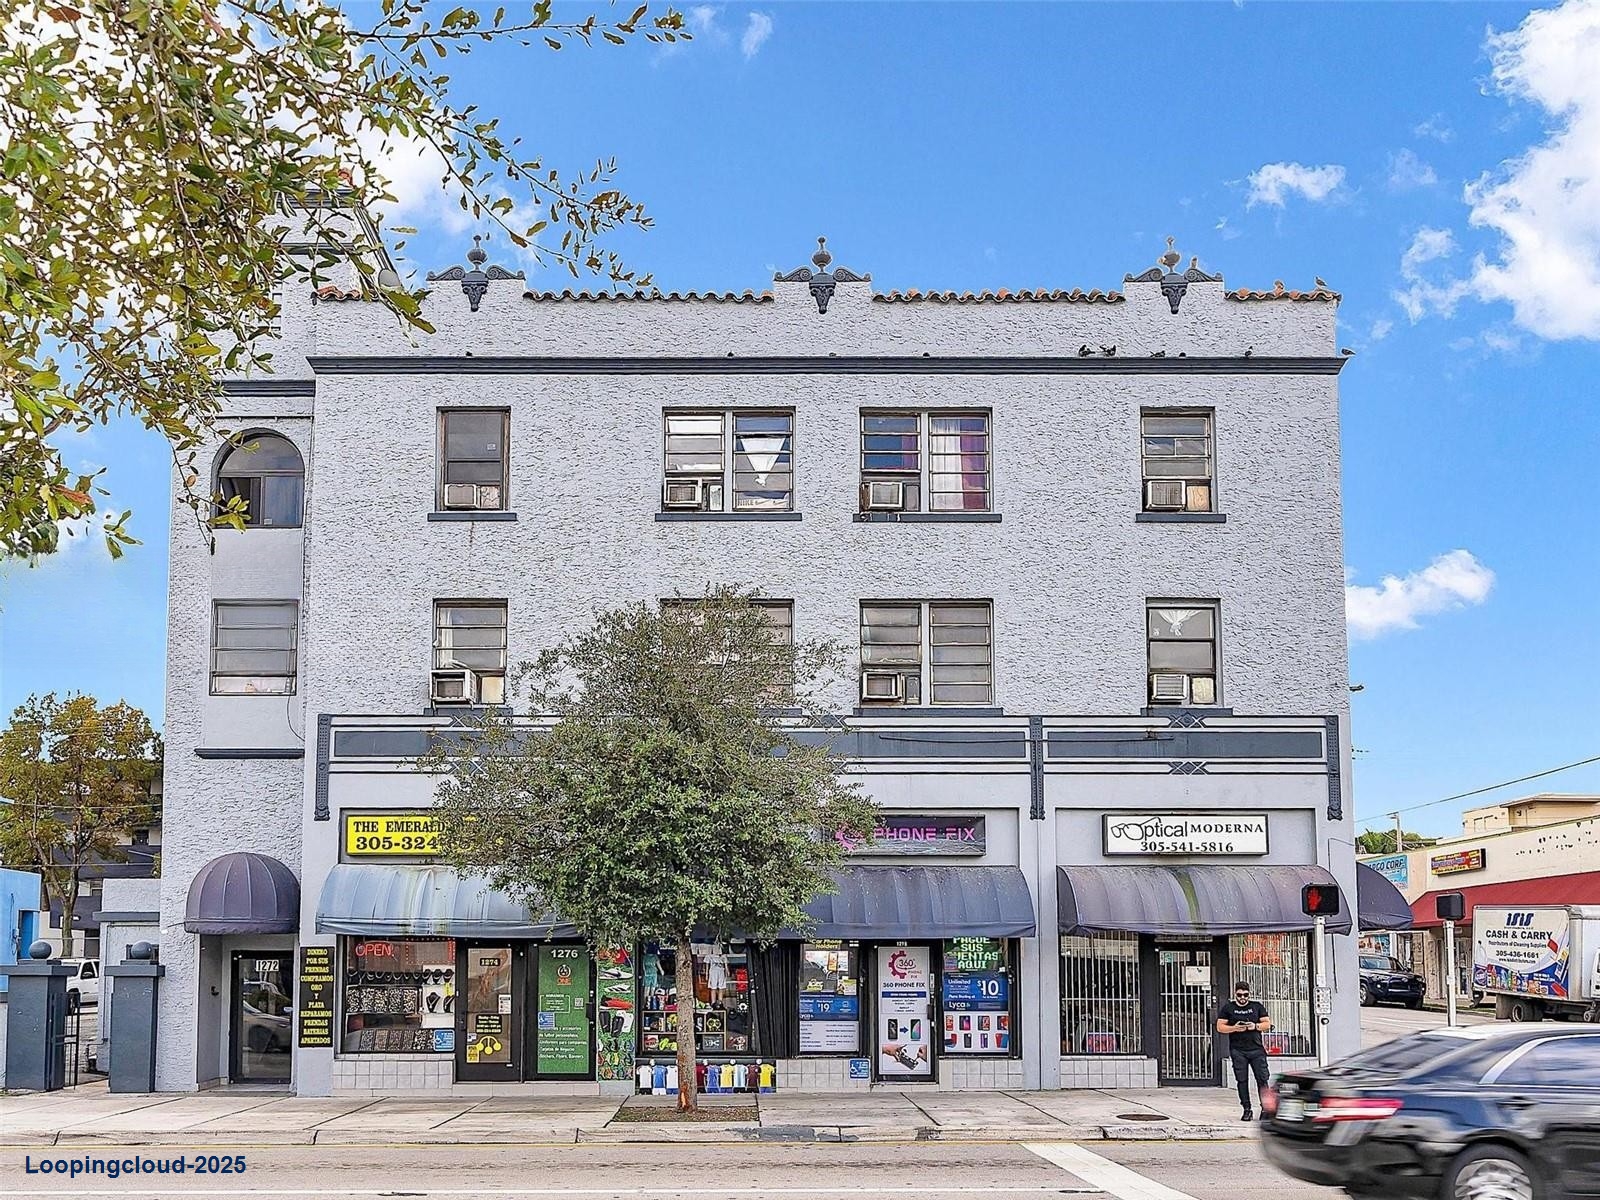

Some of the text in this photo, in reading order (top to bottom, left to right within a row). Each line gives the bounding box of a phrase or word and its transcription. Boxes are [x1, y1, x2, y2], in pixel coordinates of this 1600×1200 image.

[353, 821, 379, 832] THE
[1190, 823, 1264, 833] MODERNA
[873, 827, 937, 841] PHONE
[945, 827, 976, 841] FIX
[356, 836, 441, 850] 305-324
[1140, 841, 1234, 852] 305-541-5816
[1485, 929, 1553, 940] CASH & CARRY
[355, 943, 392, 957] OPEN
[960, 943, 984, 952] SUS
[550, 949, 578, 958] 1276
[257, 960, 278, 971] 1272
[480, 958, 499, 966] 1274
[308, 1001, 325, 1009] PLATA
[948, 1001, 966, 1009] Lyca
